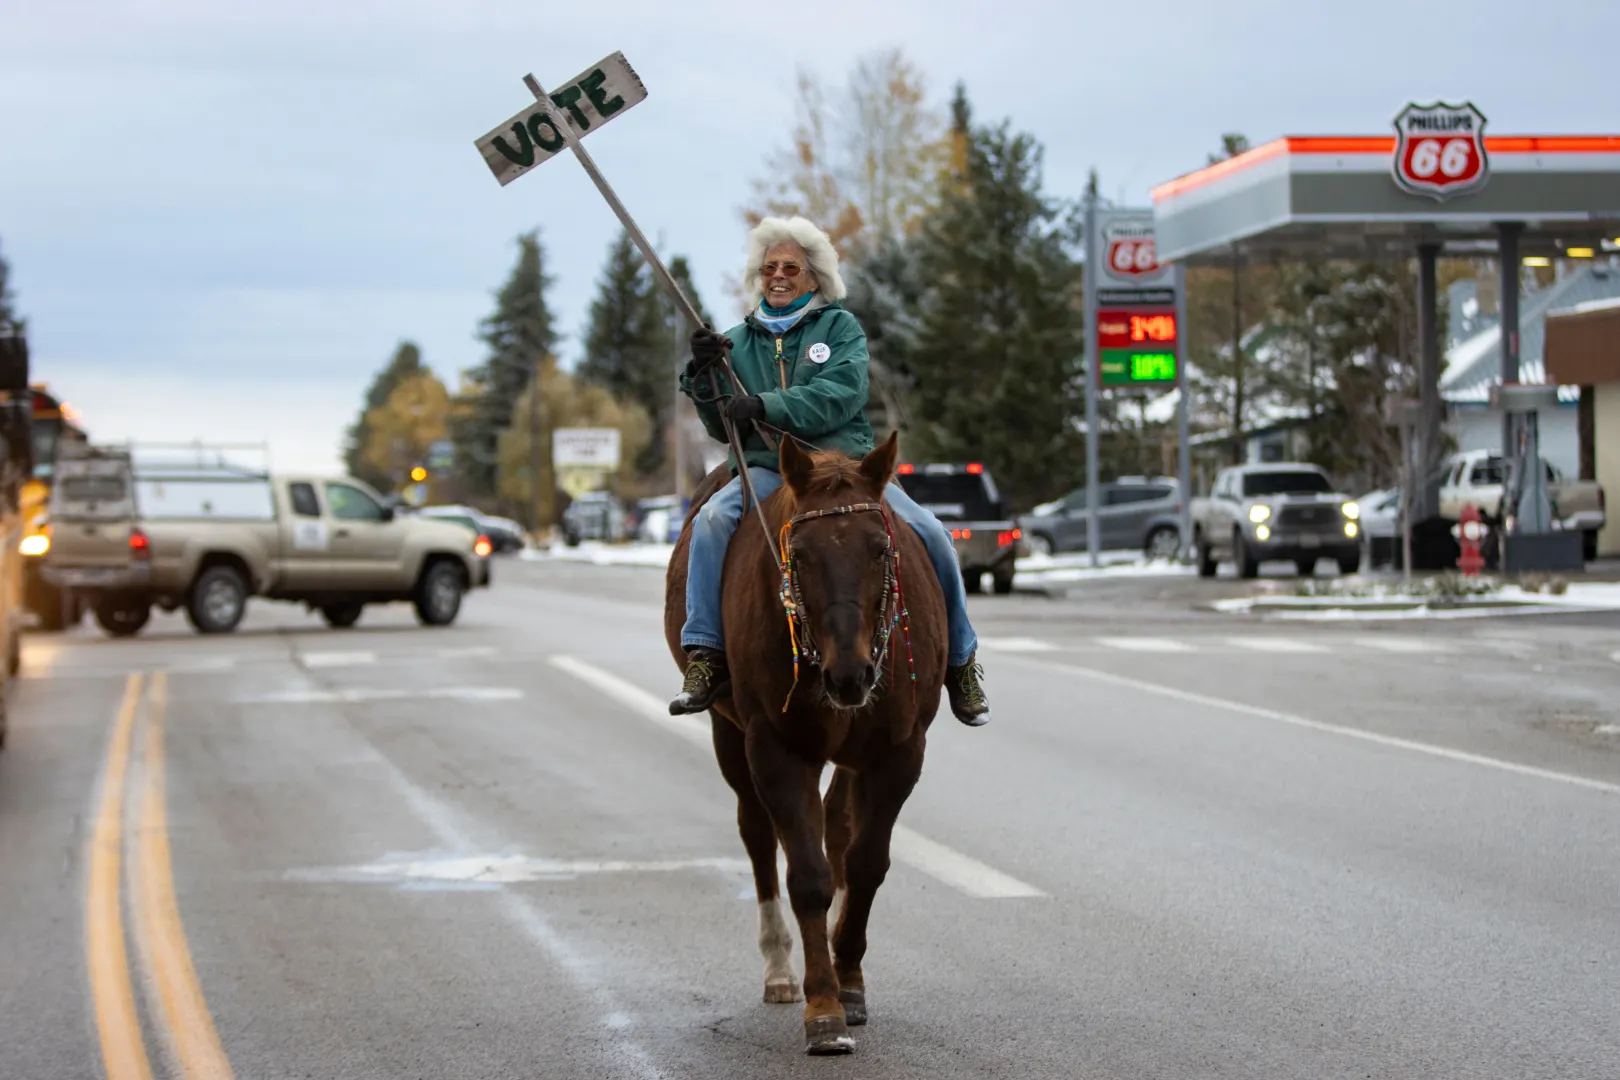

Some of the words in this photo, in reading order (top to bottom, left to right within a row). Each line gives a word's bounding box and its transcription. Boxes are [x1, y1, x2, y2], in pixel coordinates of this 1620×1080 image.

[490, 67, 625, 167] VOTE
[1408, 115, 1473, 131] PHILLIPS
[1410, 138, 1471, 178] 66
[1114, 243, 1155, 270] 66
